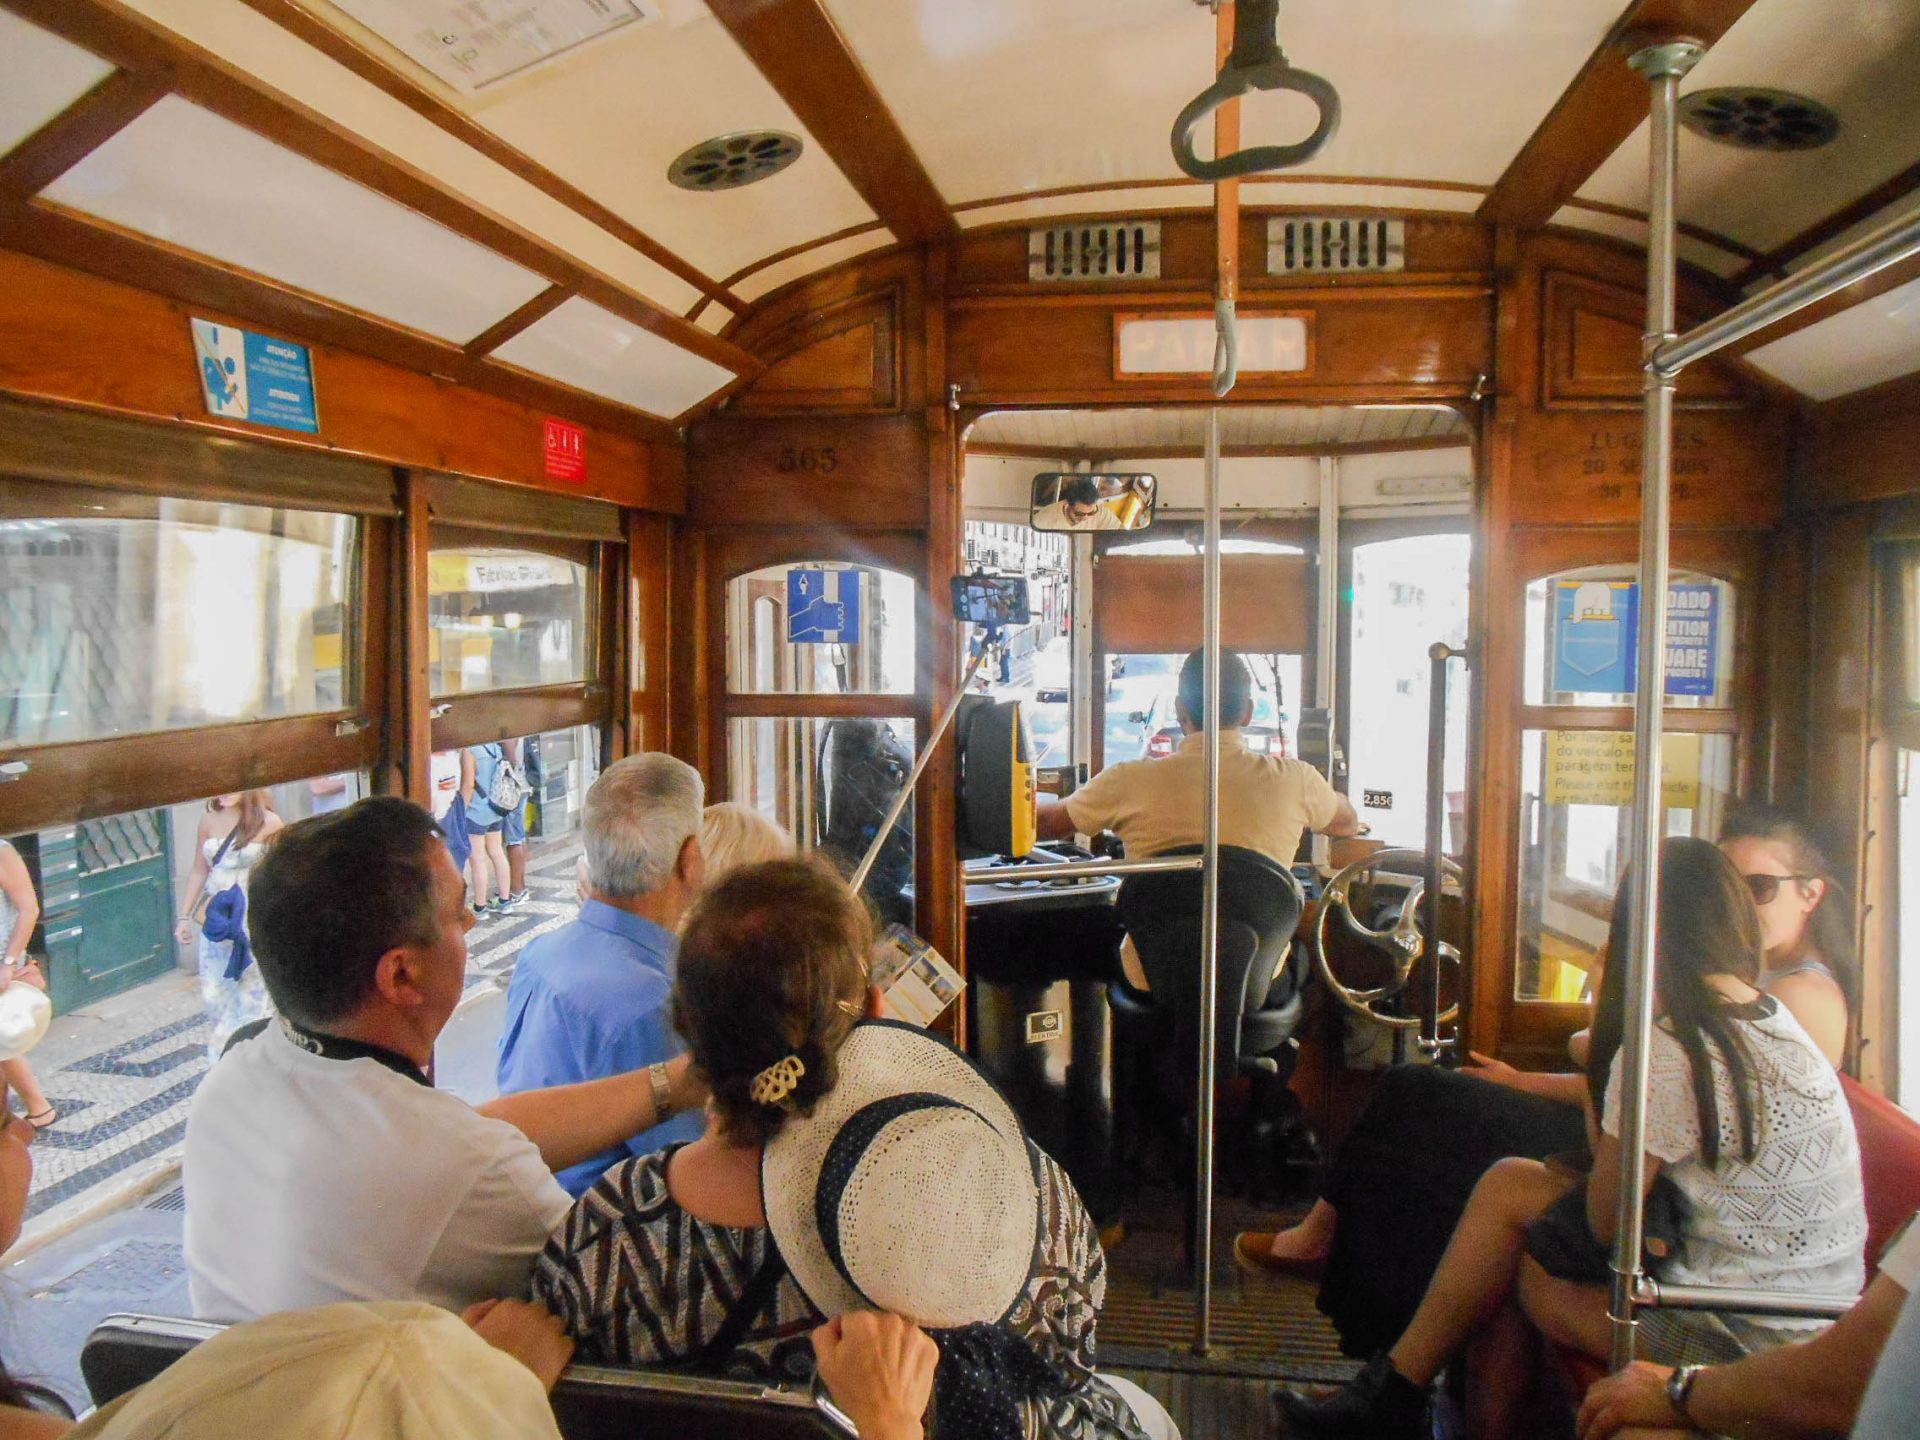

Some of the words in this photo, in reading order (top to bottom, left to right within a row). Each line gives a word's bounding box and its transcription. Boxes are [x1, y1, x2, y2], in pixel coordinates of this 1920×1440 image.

[1667, 591, 1710, 609] DADO
[1619, 734, 1633, 744] sa
[1556, 745, 1572, 757] do
